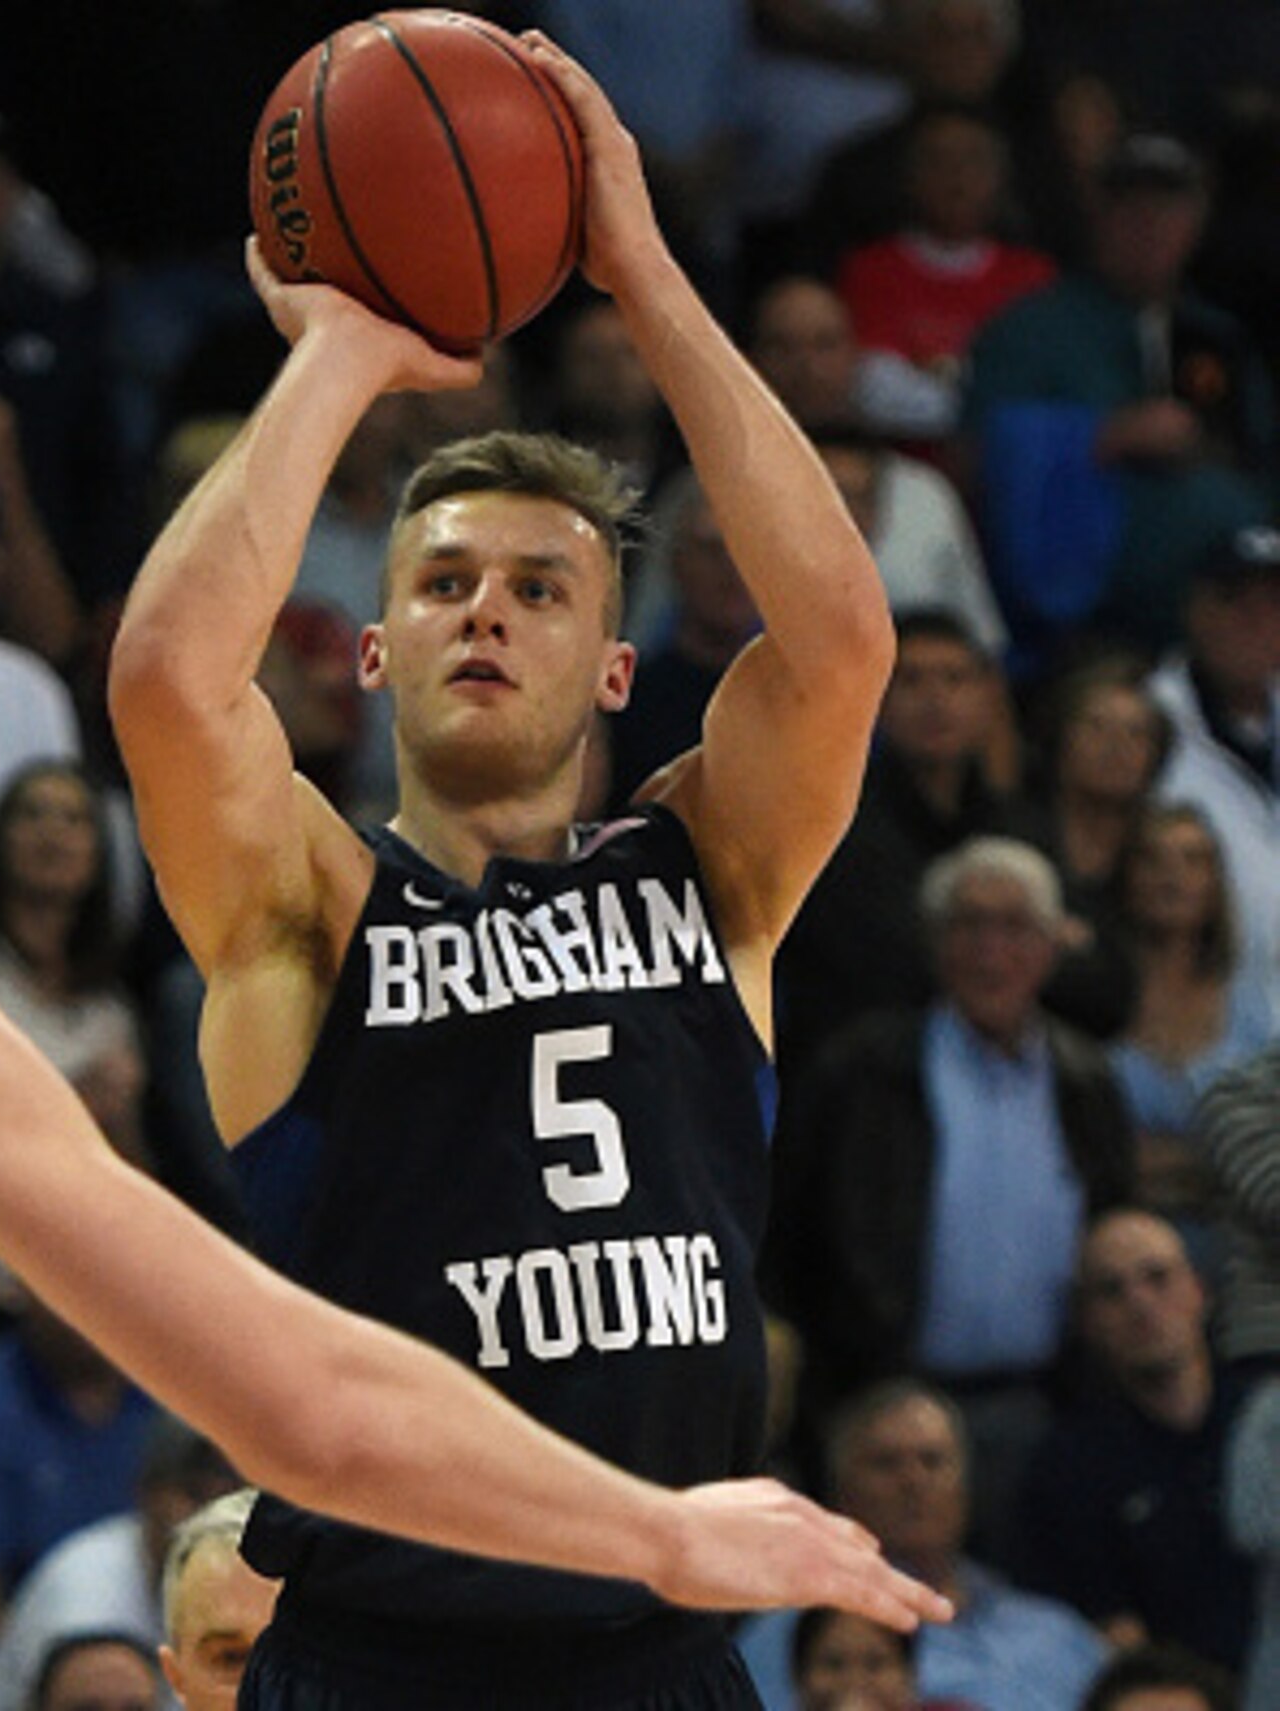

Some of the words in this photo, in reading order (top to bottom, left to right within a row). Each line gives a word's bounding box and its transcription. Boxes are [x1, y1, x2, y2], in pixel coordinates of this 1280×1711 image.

[263, 107, 325, 281] Wils
[365, 878, 726, 1028] BRIGHAM
[530, 1024, 631, 1213] 5
[443, 1232, 727, 1369] YOUNG
